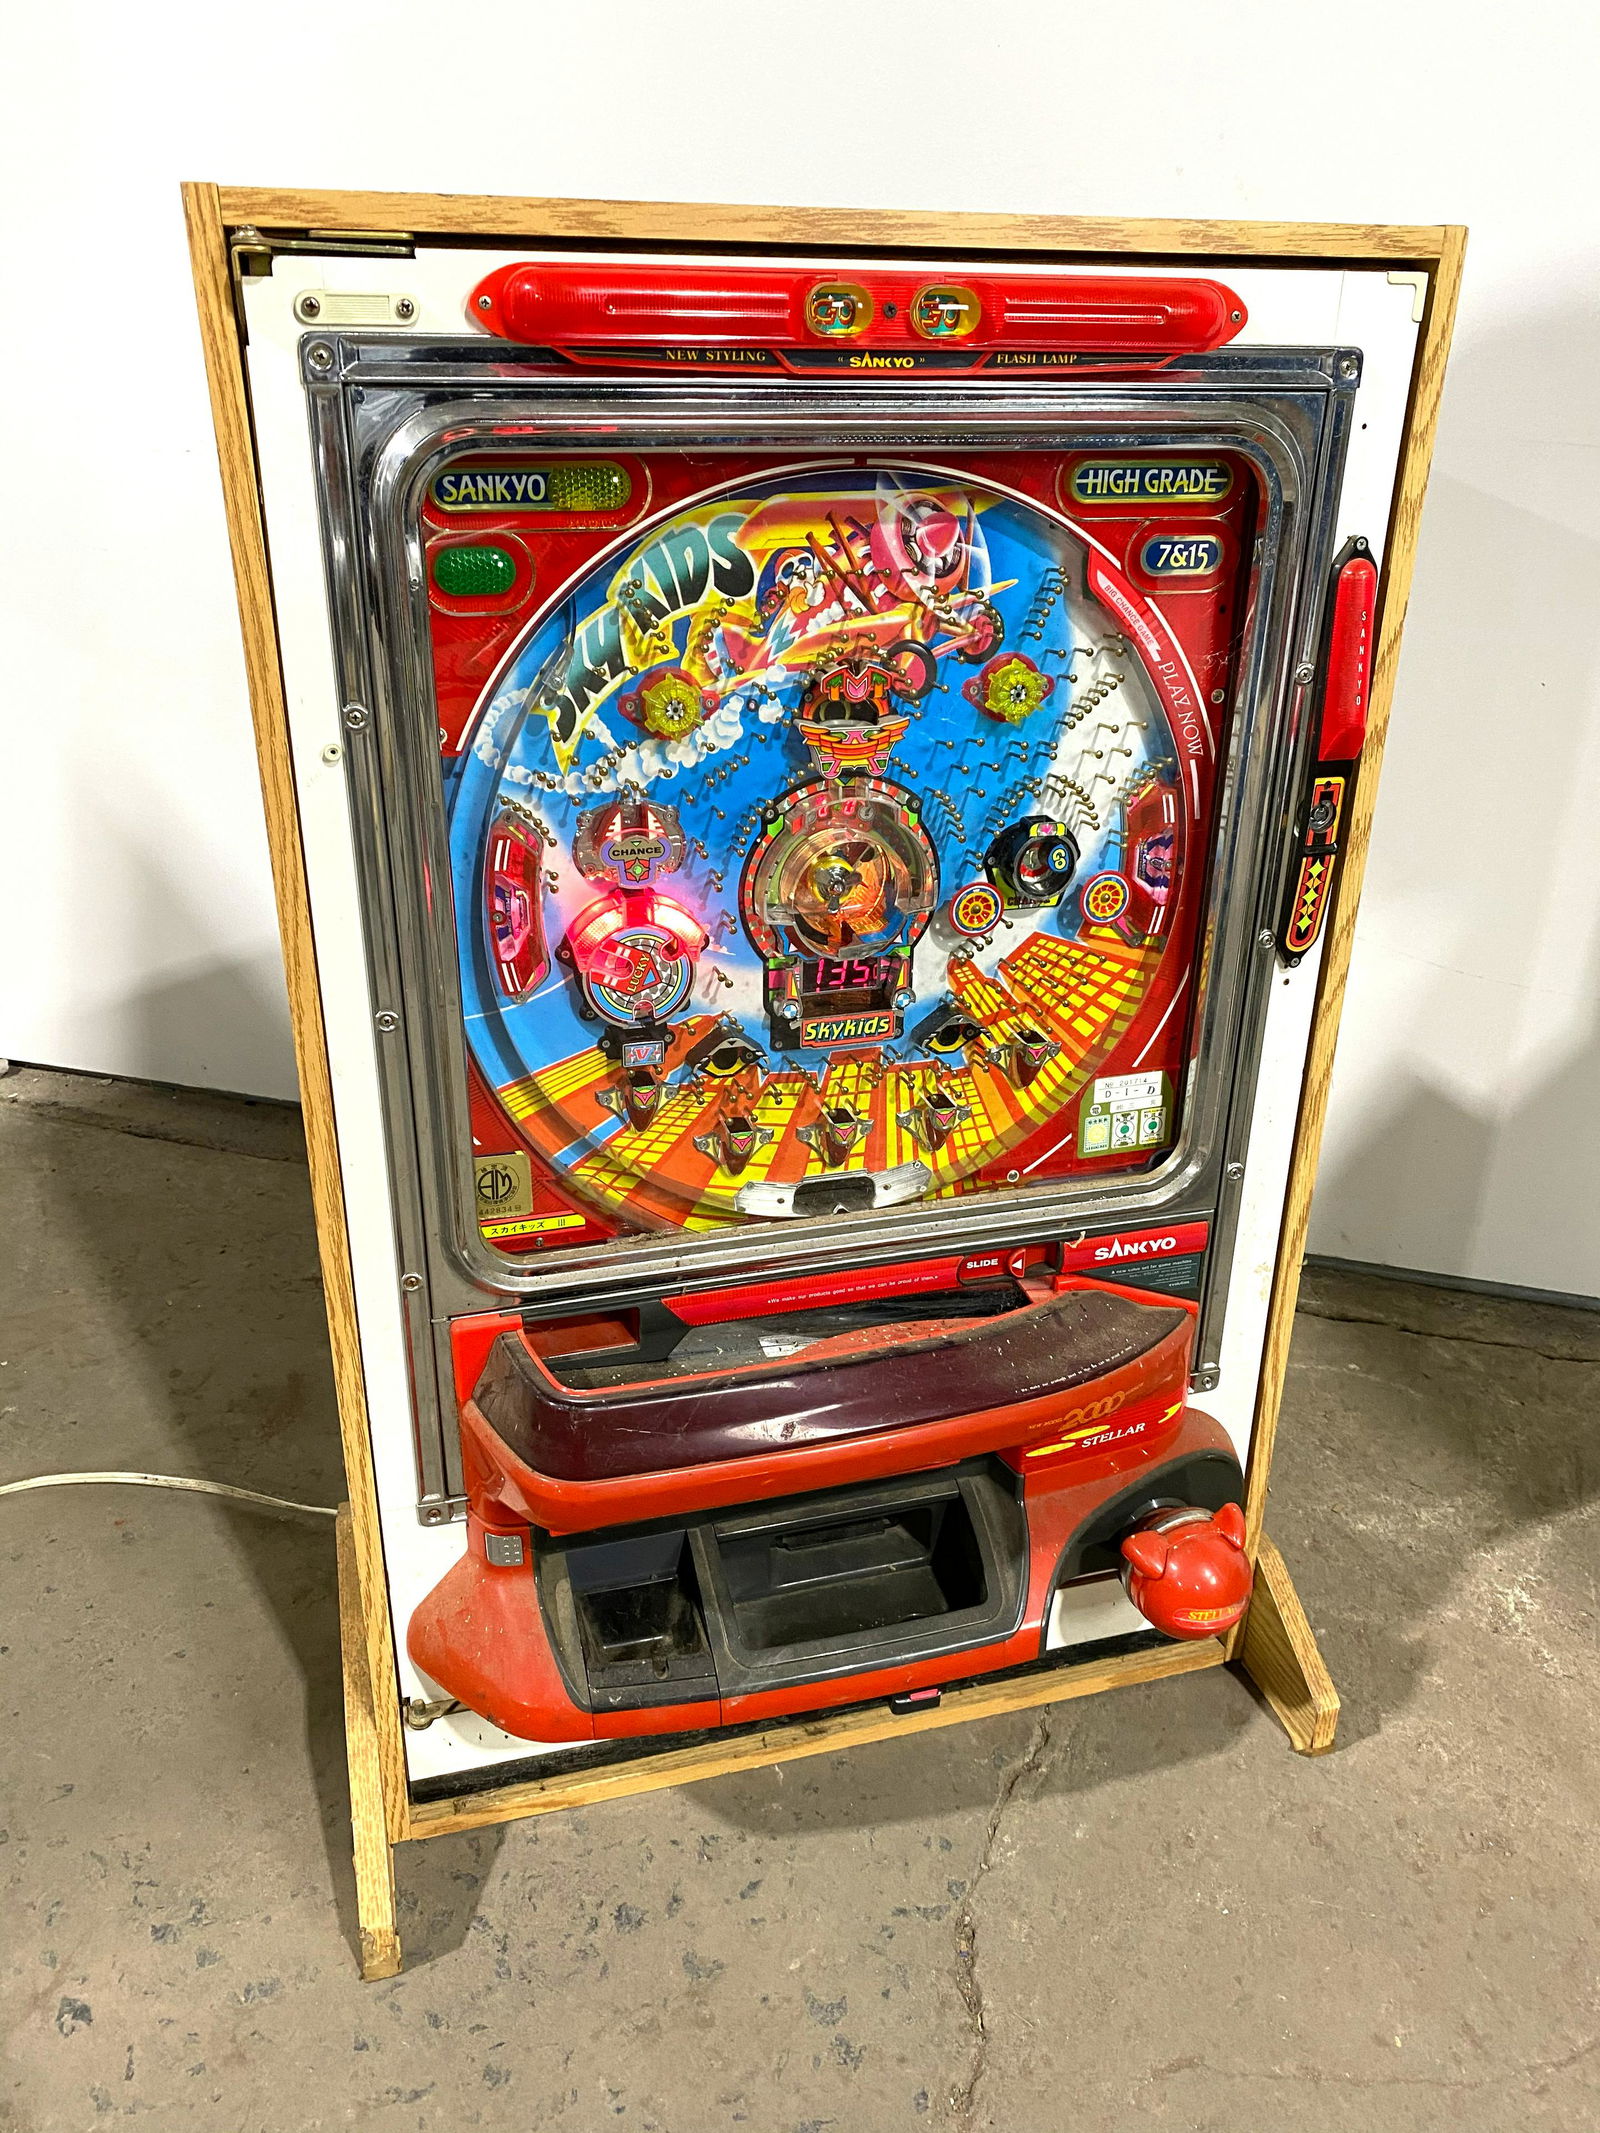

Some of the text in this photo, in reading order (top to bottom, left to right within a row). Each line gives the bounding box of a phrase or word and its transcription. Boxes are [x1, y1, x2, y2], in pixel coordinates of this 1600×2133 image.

[665, 350, 766, 361] NEW STYLING
[849, 351, 915, 368] SANKYO
[996, 353, 1078, 365] FLASH LAMP
[441, 473, 546, 503] SANKYO
[1085, 468, 1219, 494] HIGH GRADE
[1156, 542, 1210, 571] 7&15
[617, 514, 756, 637] KIDS
[1104, 584, 1118, 598] BIG
[1115, 597, 1140, 626] CHANCE
[1355, 611, 1367, 706] SANKYO
[1158, 661, 1204, 756] PLAY NOW
[612, 846, 662, 857] CHANCE
[627, 953, 650, 993] LUCKY
[804, 1016, 890, 1041] Skykids
[634, 1047, 652, 1061] V
[491, 1220, 545, 1235] スカイキッズ
[1094, 1237, 1177, 1261] SANKYO
[966, 1258, 999, 1270] SLIDE
[808, 1290, 831, 1299] products
[897, 1278, 912, 1286] proud
[1057, 1390, 1127, 1433] 2000
[1081, 1422, 1146, 1449] STELLAR
